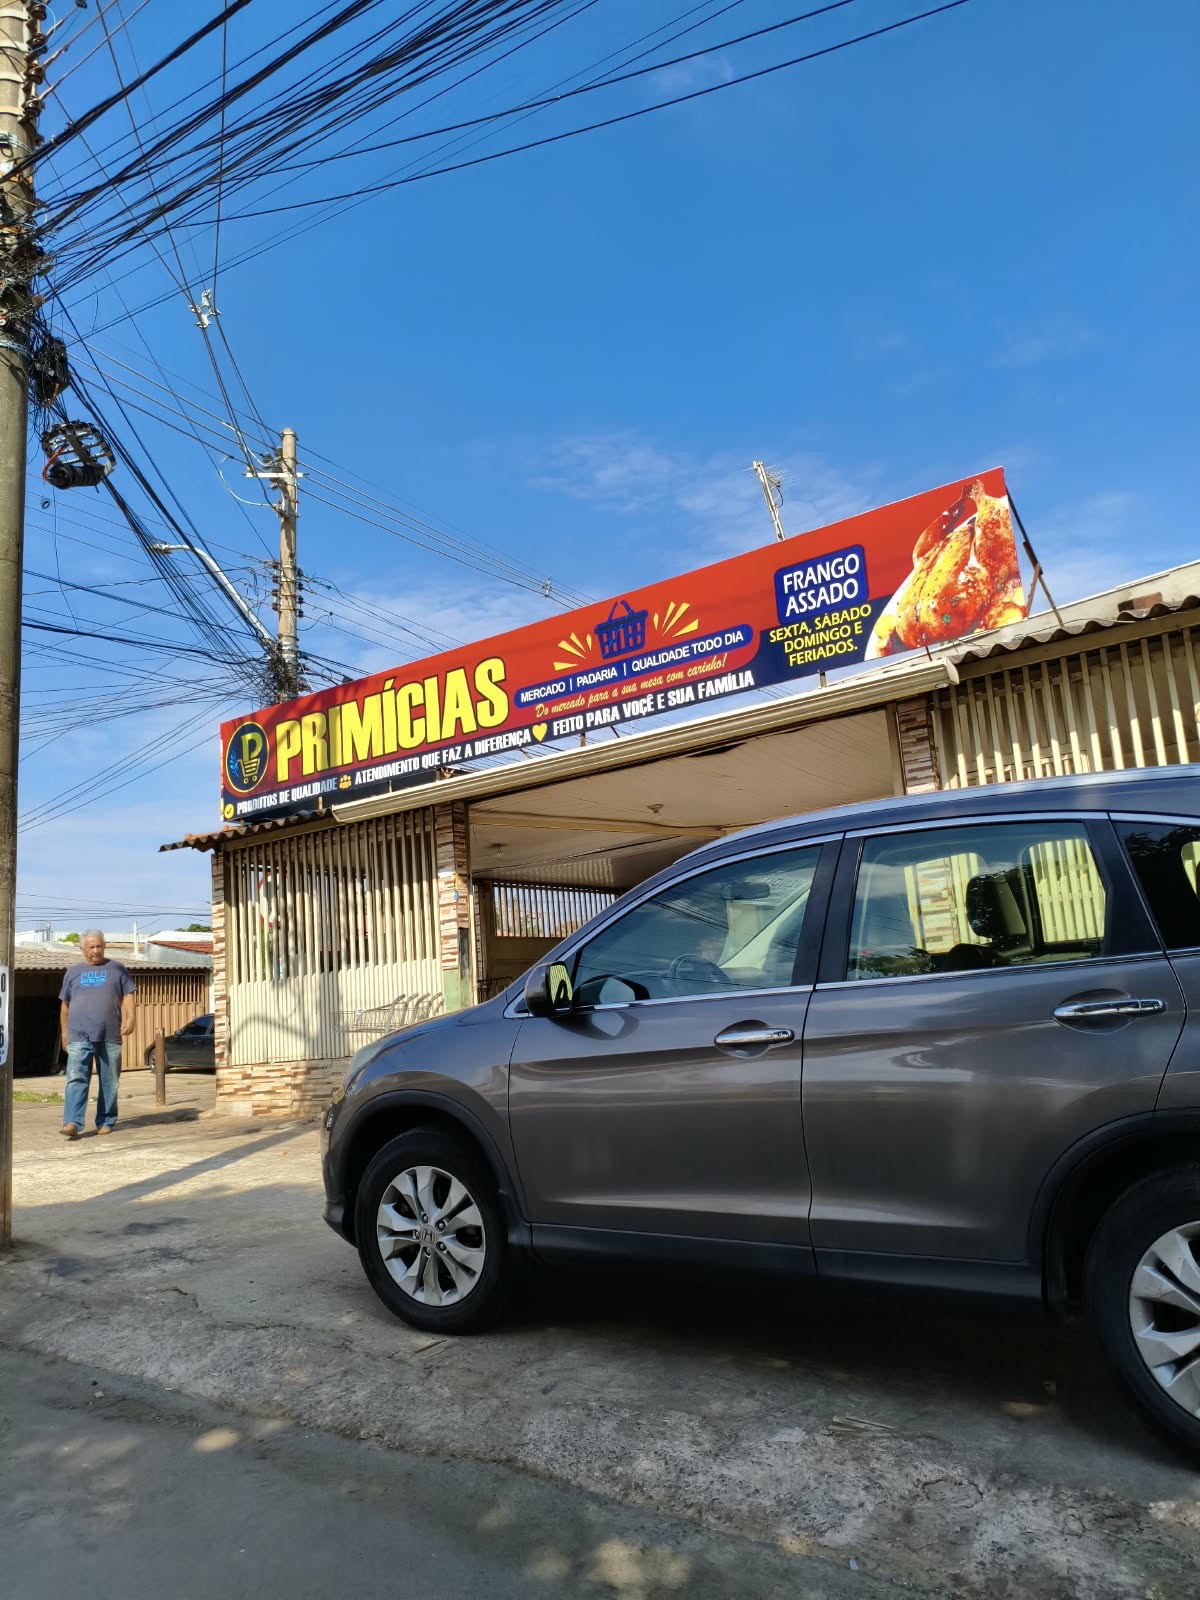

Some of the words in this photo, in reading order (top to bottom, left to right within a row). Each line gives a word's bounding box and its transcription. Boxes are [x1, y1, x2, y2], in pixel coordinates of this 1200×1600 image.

[783, 553, 860, 594] FRANGO
[785, 578, 859, 617] ASSADO
[769, 621, 812, 643] SEXTA,
[814, 603, 872, 630] SÁBADO
[784, 624, 851, 654] DOMINGO
[854, 620, 863, 635] E
[520, 681, 566, 703] MERCADO
[576, 667, 618, 687] PADARIA
[631, 645, 690, 672] QUALIDADE
[691, 636, 722, 655] TODO
[724, 630, 744, 646] DIA
[789, 638, 858, 667] FERIADOS.
[535, 703, 549, 718] Do
[551, 694, 586, 714] mercado
[587, 691, 609, 708] para
[611, 688, 619, 698] a
[621, 682, 638, 695] sua
[640, 675, 664, 690] mesa
[666, 670, 685, 684] com
[687, 652, 728, 677] carinho!
[553, 715, 584, 737] FEITO
[586, 704, 621, 728] PARA
[657, 693, 666, 710] E
[667, 685, 696, 707] SUA
[698, 669, 755, 700] FAMÍLIA
[275, 657, 509, 783] PRIMÍCIAS
[355, 757, 420, 786] ATENDIMENTO
[421, 750, 441, 768] QUE
[442, 746, 462, 764] FAZ
[464, 746, 473, 759] A
[474, 728, 532, 755] DIFERENÇA
[279, 789, 290, 803] DE
[291, 776, 338, 801] QUALIDADE
